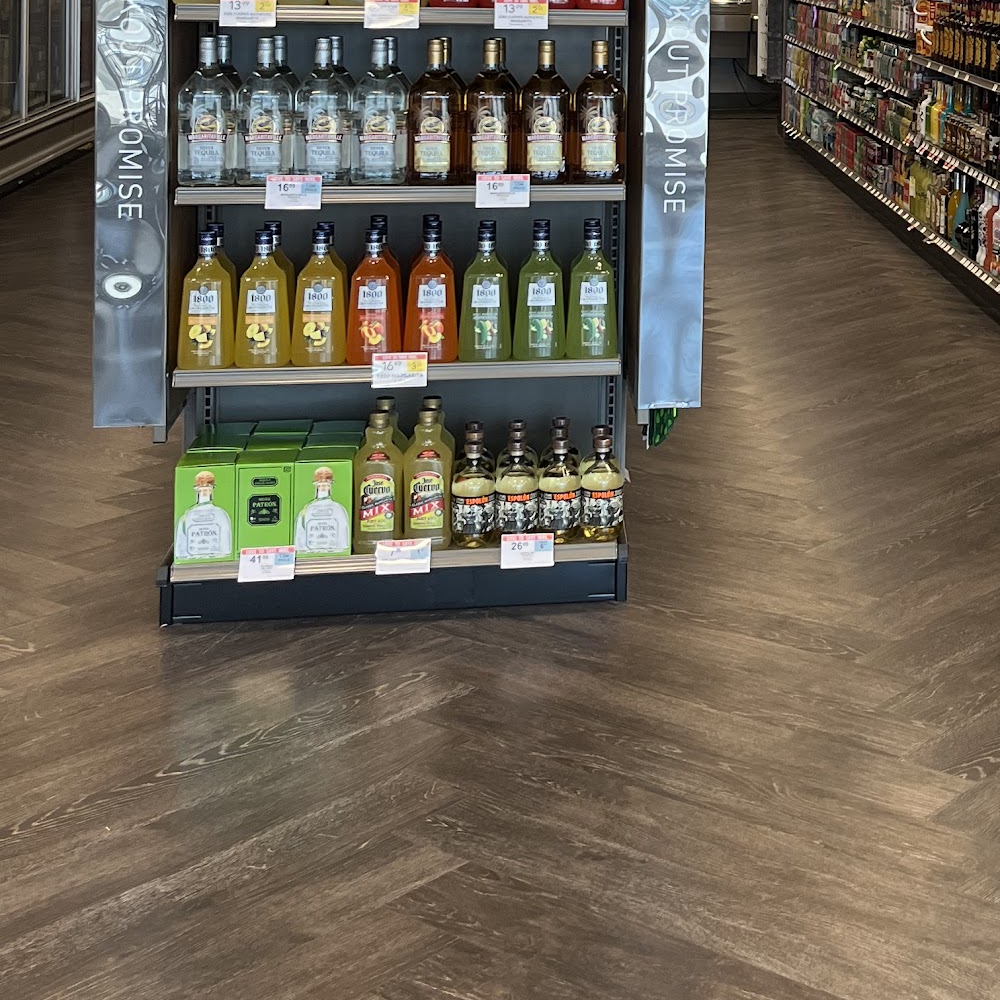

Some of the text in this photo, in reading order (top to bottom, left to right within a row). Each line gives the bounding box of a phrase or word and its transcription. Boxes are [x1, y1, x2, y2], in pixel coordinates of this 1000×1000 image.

[117, 89, 144, 220] PROMISE
[662, 90, 689, 215] PROMISE
[362, 290, 383, 299] 1800
[422, 288, 443, 298] 1800
[476, 288, 497, 297] 1800
[532, 288, 552, 296] 1800
[584, 286, 604, 295] 1800
[193, 295, 215, 303] 1800
[250, 294, 272, 303] 1800
[308, 292, 329, 301] 1800
[363, 485, 391, 496] Cuervo
[413, 482, 440, 493] Cuervo
[362, 503, 390, 519] MIX
[412, 500, 440, 516] MIX
